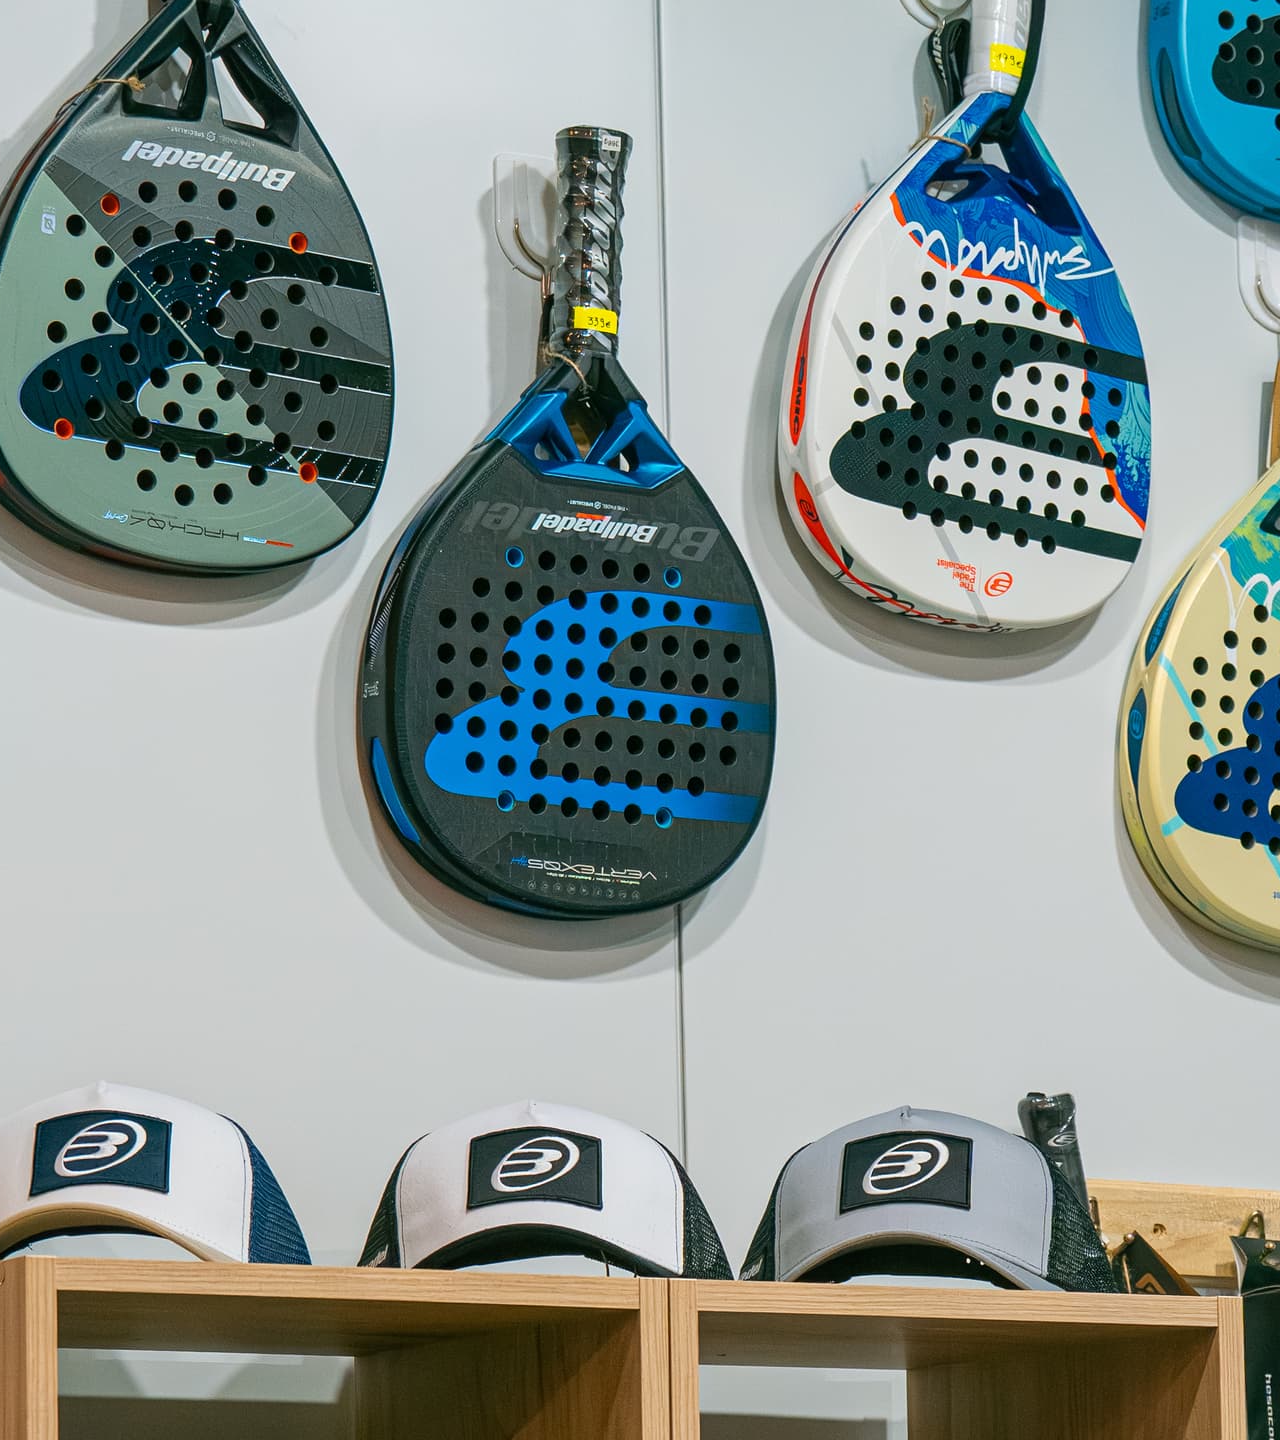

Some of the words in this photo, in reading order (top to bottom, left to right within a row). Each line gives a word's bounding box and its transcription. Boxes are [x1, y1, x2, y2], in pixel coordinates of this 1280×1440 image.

[121, 139, 297, 192] Bullpadel
[530, 511, 659, 544] Bullpadel
[936, 558, 977, 576] Specialist
[952, 571, 976, 585] Padel
